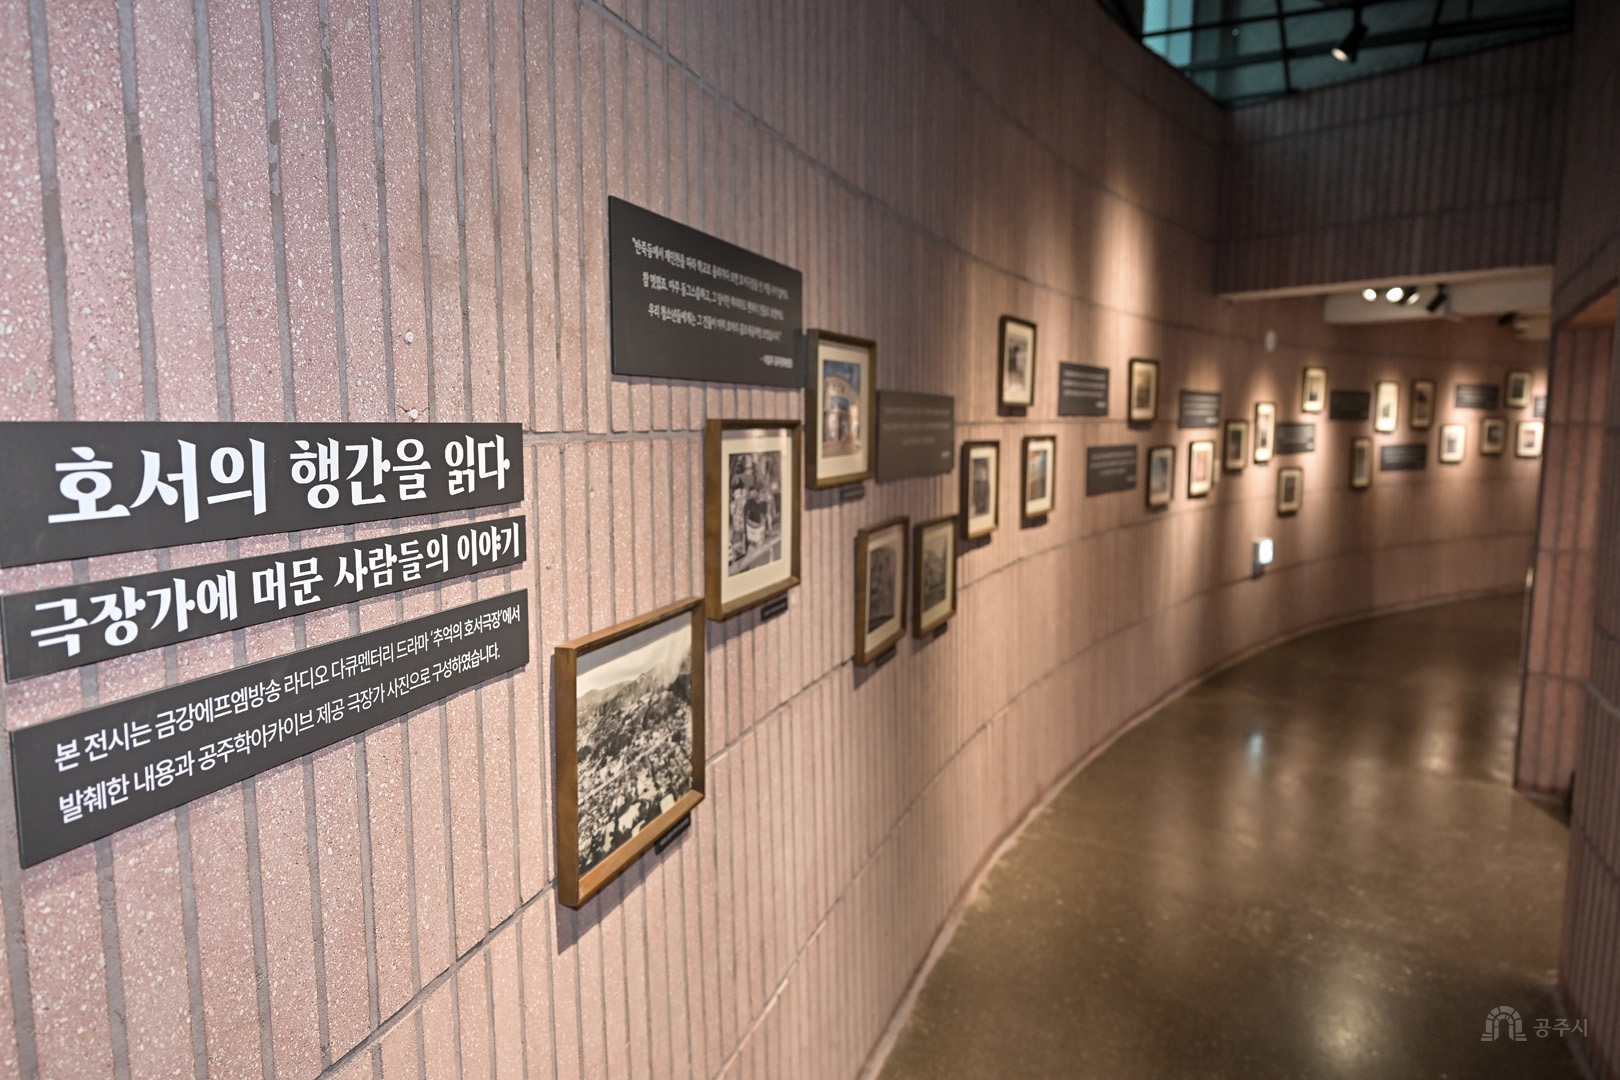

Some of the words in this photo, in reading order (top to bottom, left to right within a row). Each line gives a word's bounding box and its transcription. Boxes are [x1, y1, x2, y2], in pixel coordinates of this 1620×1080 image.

[648, 303, 660, 318] 우리
[48, 438, 266, 523] 호서의
[290, 437, 431, 508] 행간을
[445, 434, 510, 495] 읽다
[31, 570, 237, 656] 극장가에
[253, 557, 323, 609] 머문
[334, 534, 448, 592] 사람들의
[458, 522, 519, 566] 이야기
[55, 739, 80, 772] 본
[84, 722, 152, 761] 전시는
[155, 679, 281, 739] 금강에프엠방송
[284, 666, 329, 693] 라디오
[332, 643, 393, 678] 다큐멘터리
[397, 632, 429, 658] 드라마
[59, 774, 129, 823] 발췌한
[134, 752, 195, 791] 내용과
[198, 710, 314, 770] 공주학아카이브
[317, 699, 345, 723] 제공
[348, 683, 385, 712] 극장가
[387, 668, 431, 697] 사진으로
[432, 642, 500, 681] 구성하였습니다.
